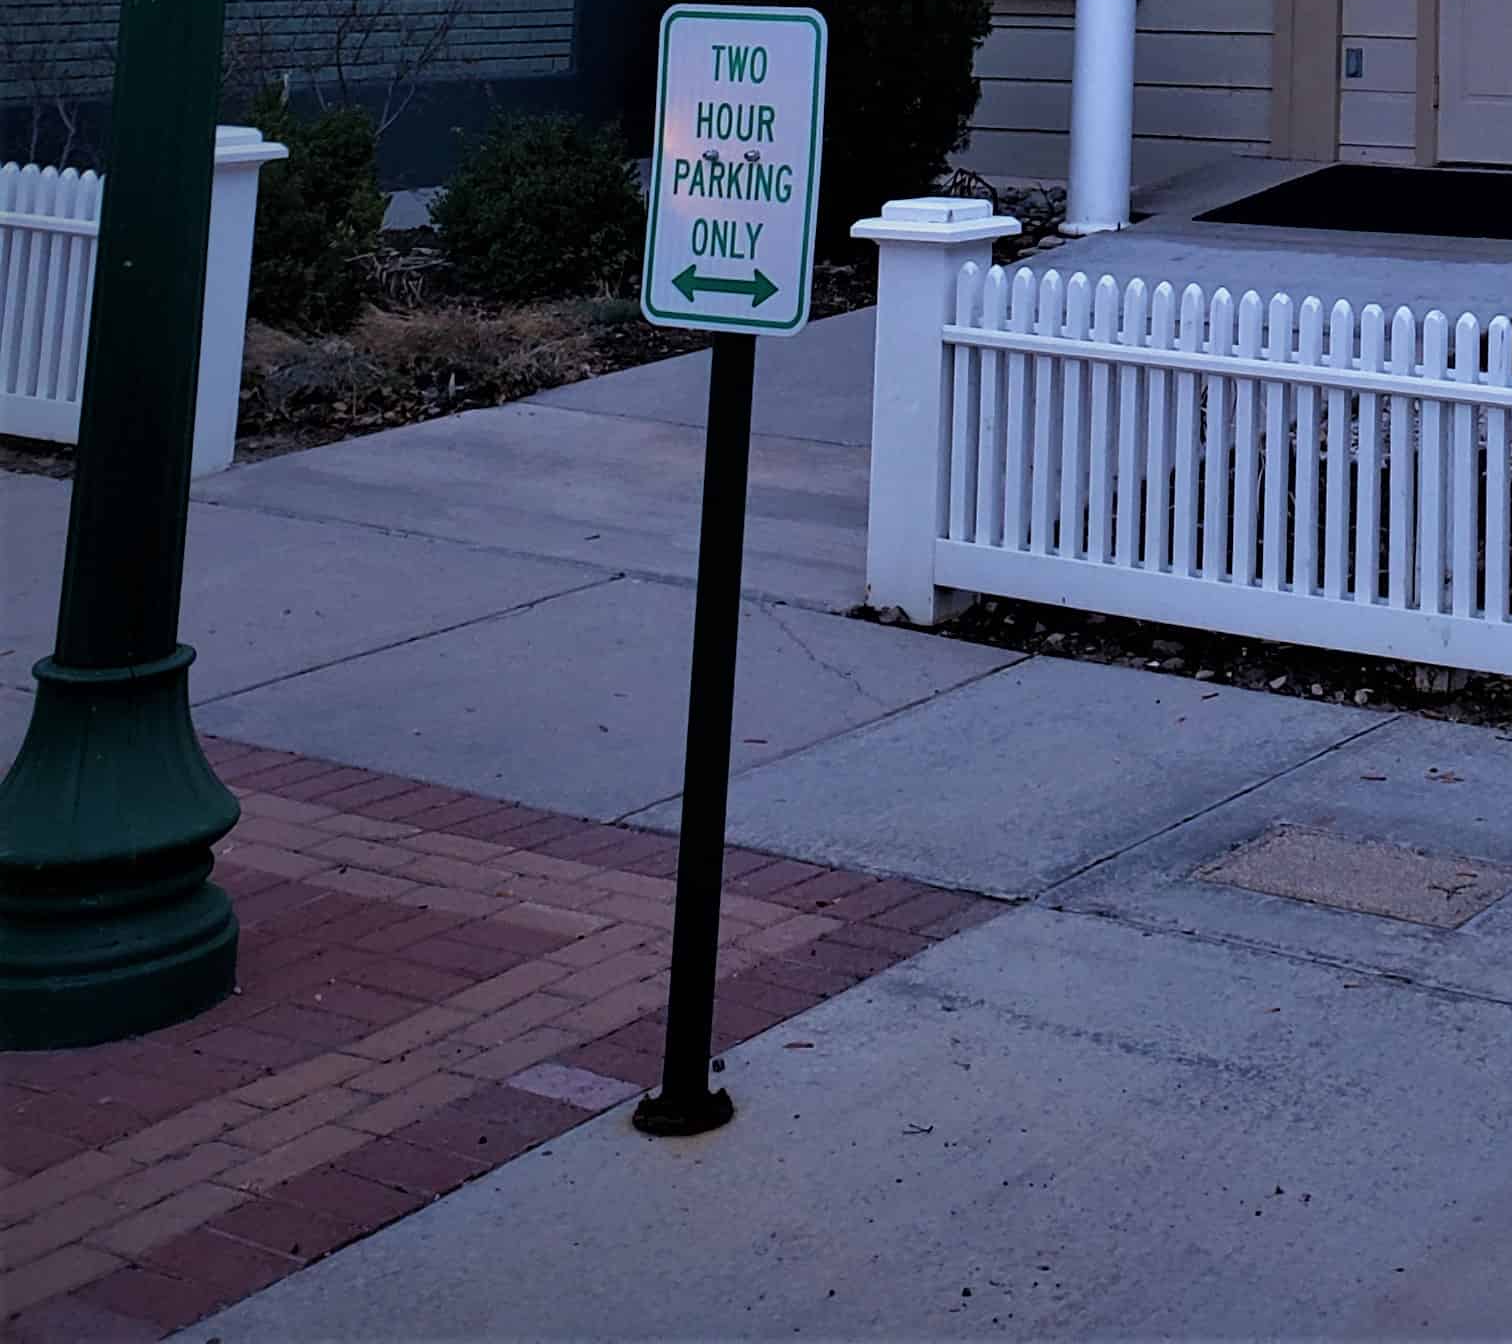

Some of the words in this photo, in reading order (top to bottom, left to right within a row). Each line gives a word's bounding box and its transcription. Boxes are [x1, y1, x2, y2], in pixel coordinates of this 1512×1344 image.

[711, 45, 768, 84] TWO
[696, 101, 776, 143] HOUR
[673, 158, 793, 203] PARKING
[692, 218, 764, 260] ONLY
